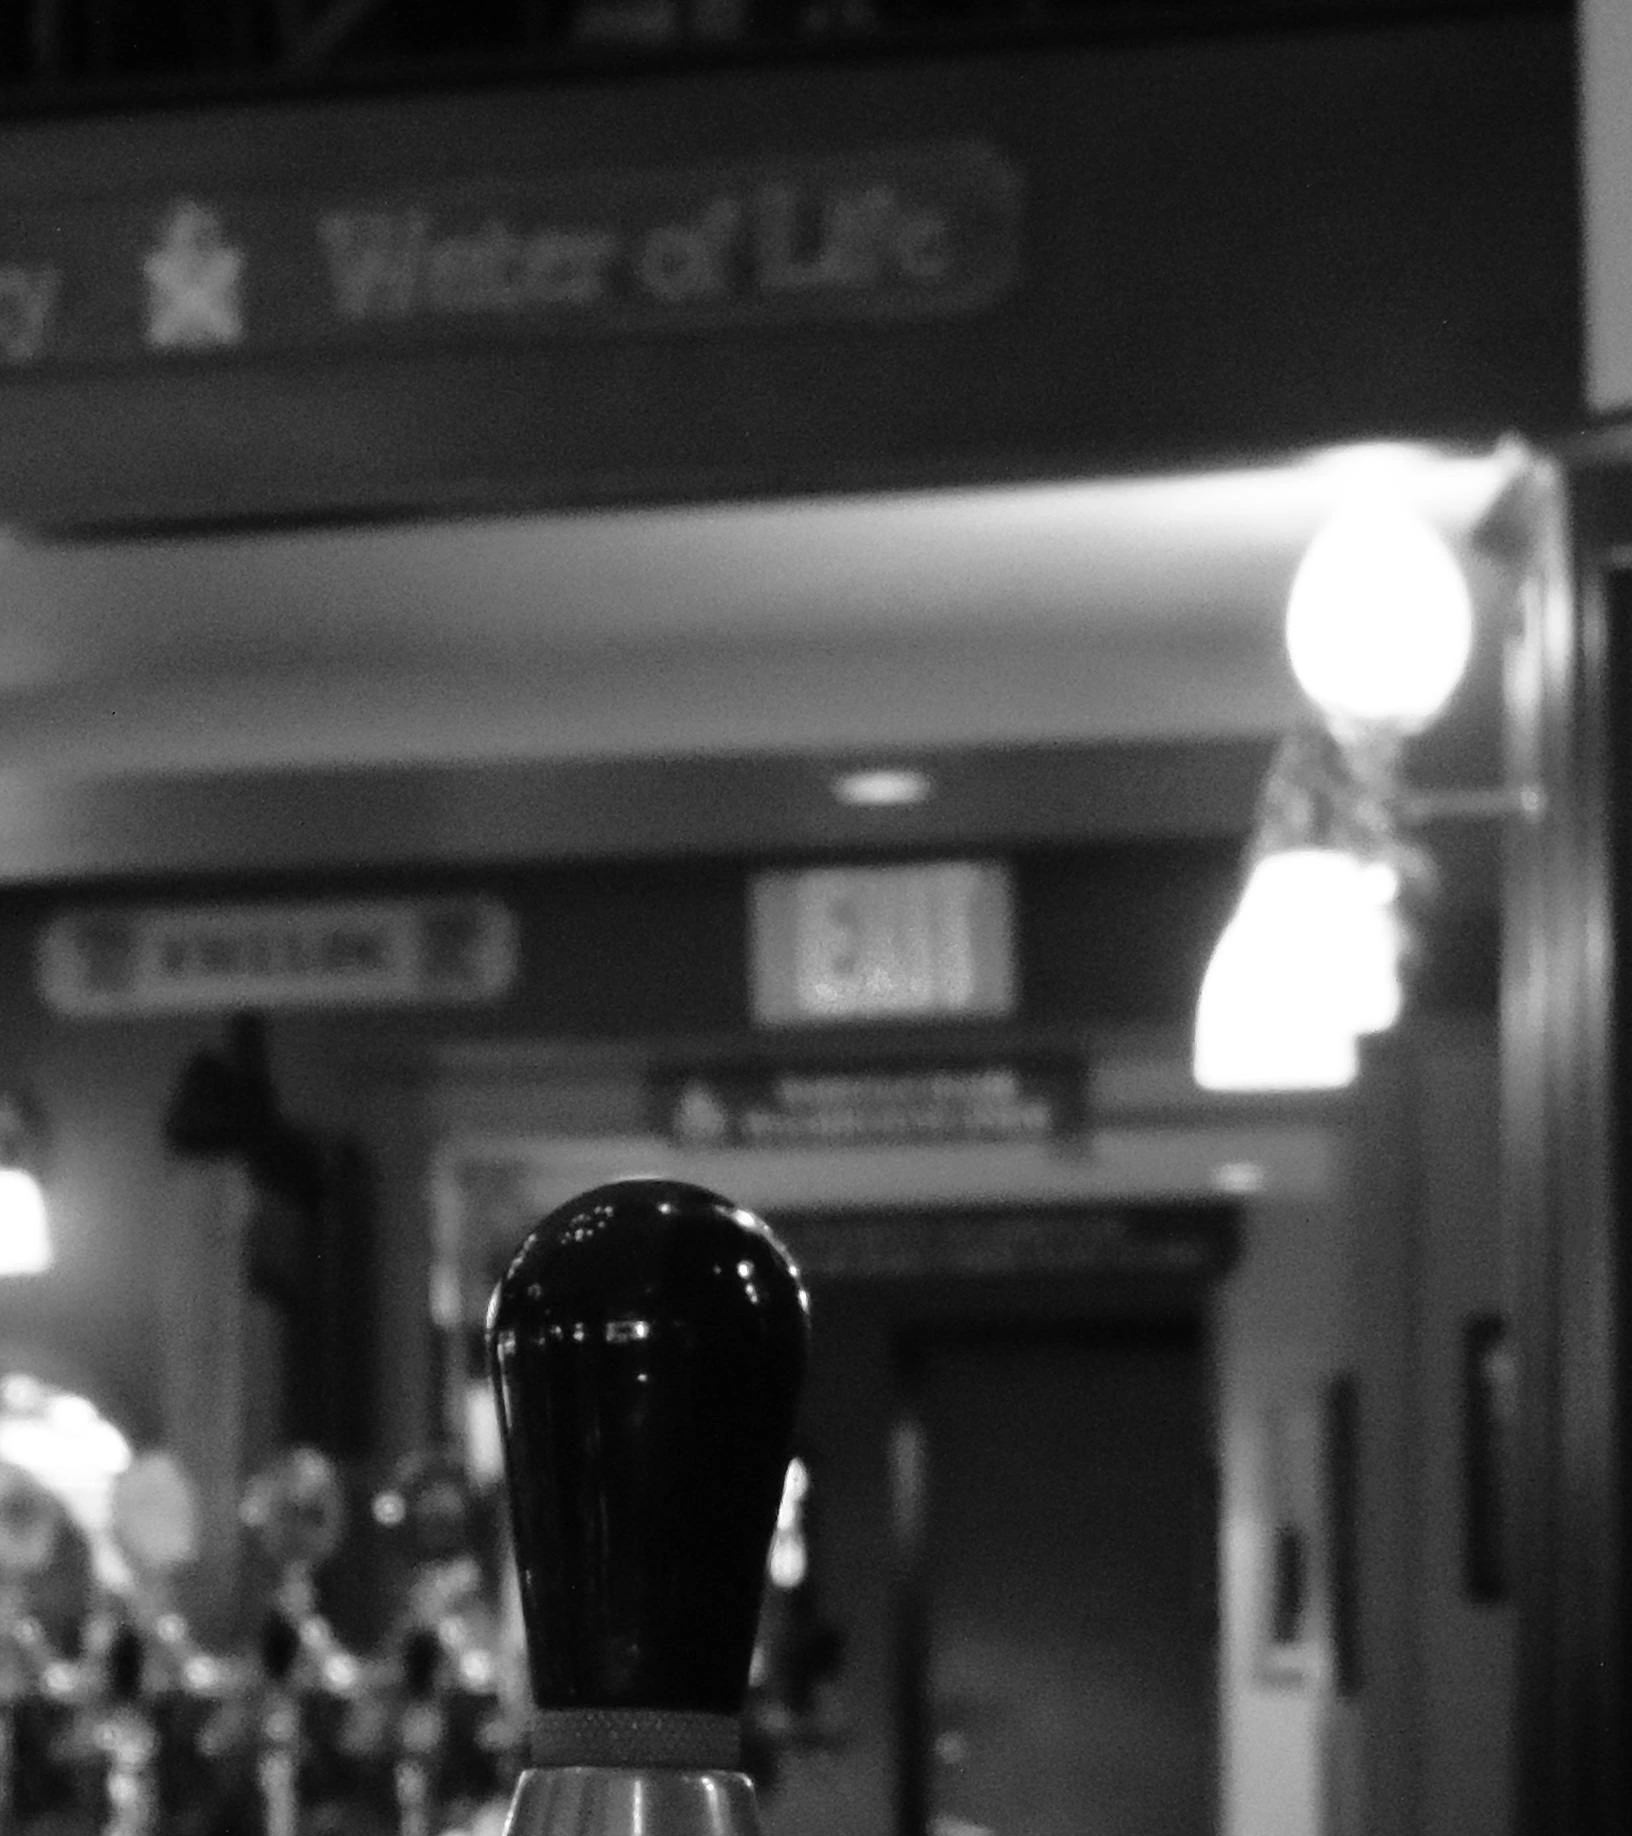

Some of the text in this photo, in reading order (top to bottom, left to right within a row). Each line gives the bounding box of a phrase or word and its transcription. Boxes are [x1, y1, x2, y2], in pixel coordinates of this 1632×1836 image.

[320, 184, 947, 322] Water of Life
